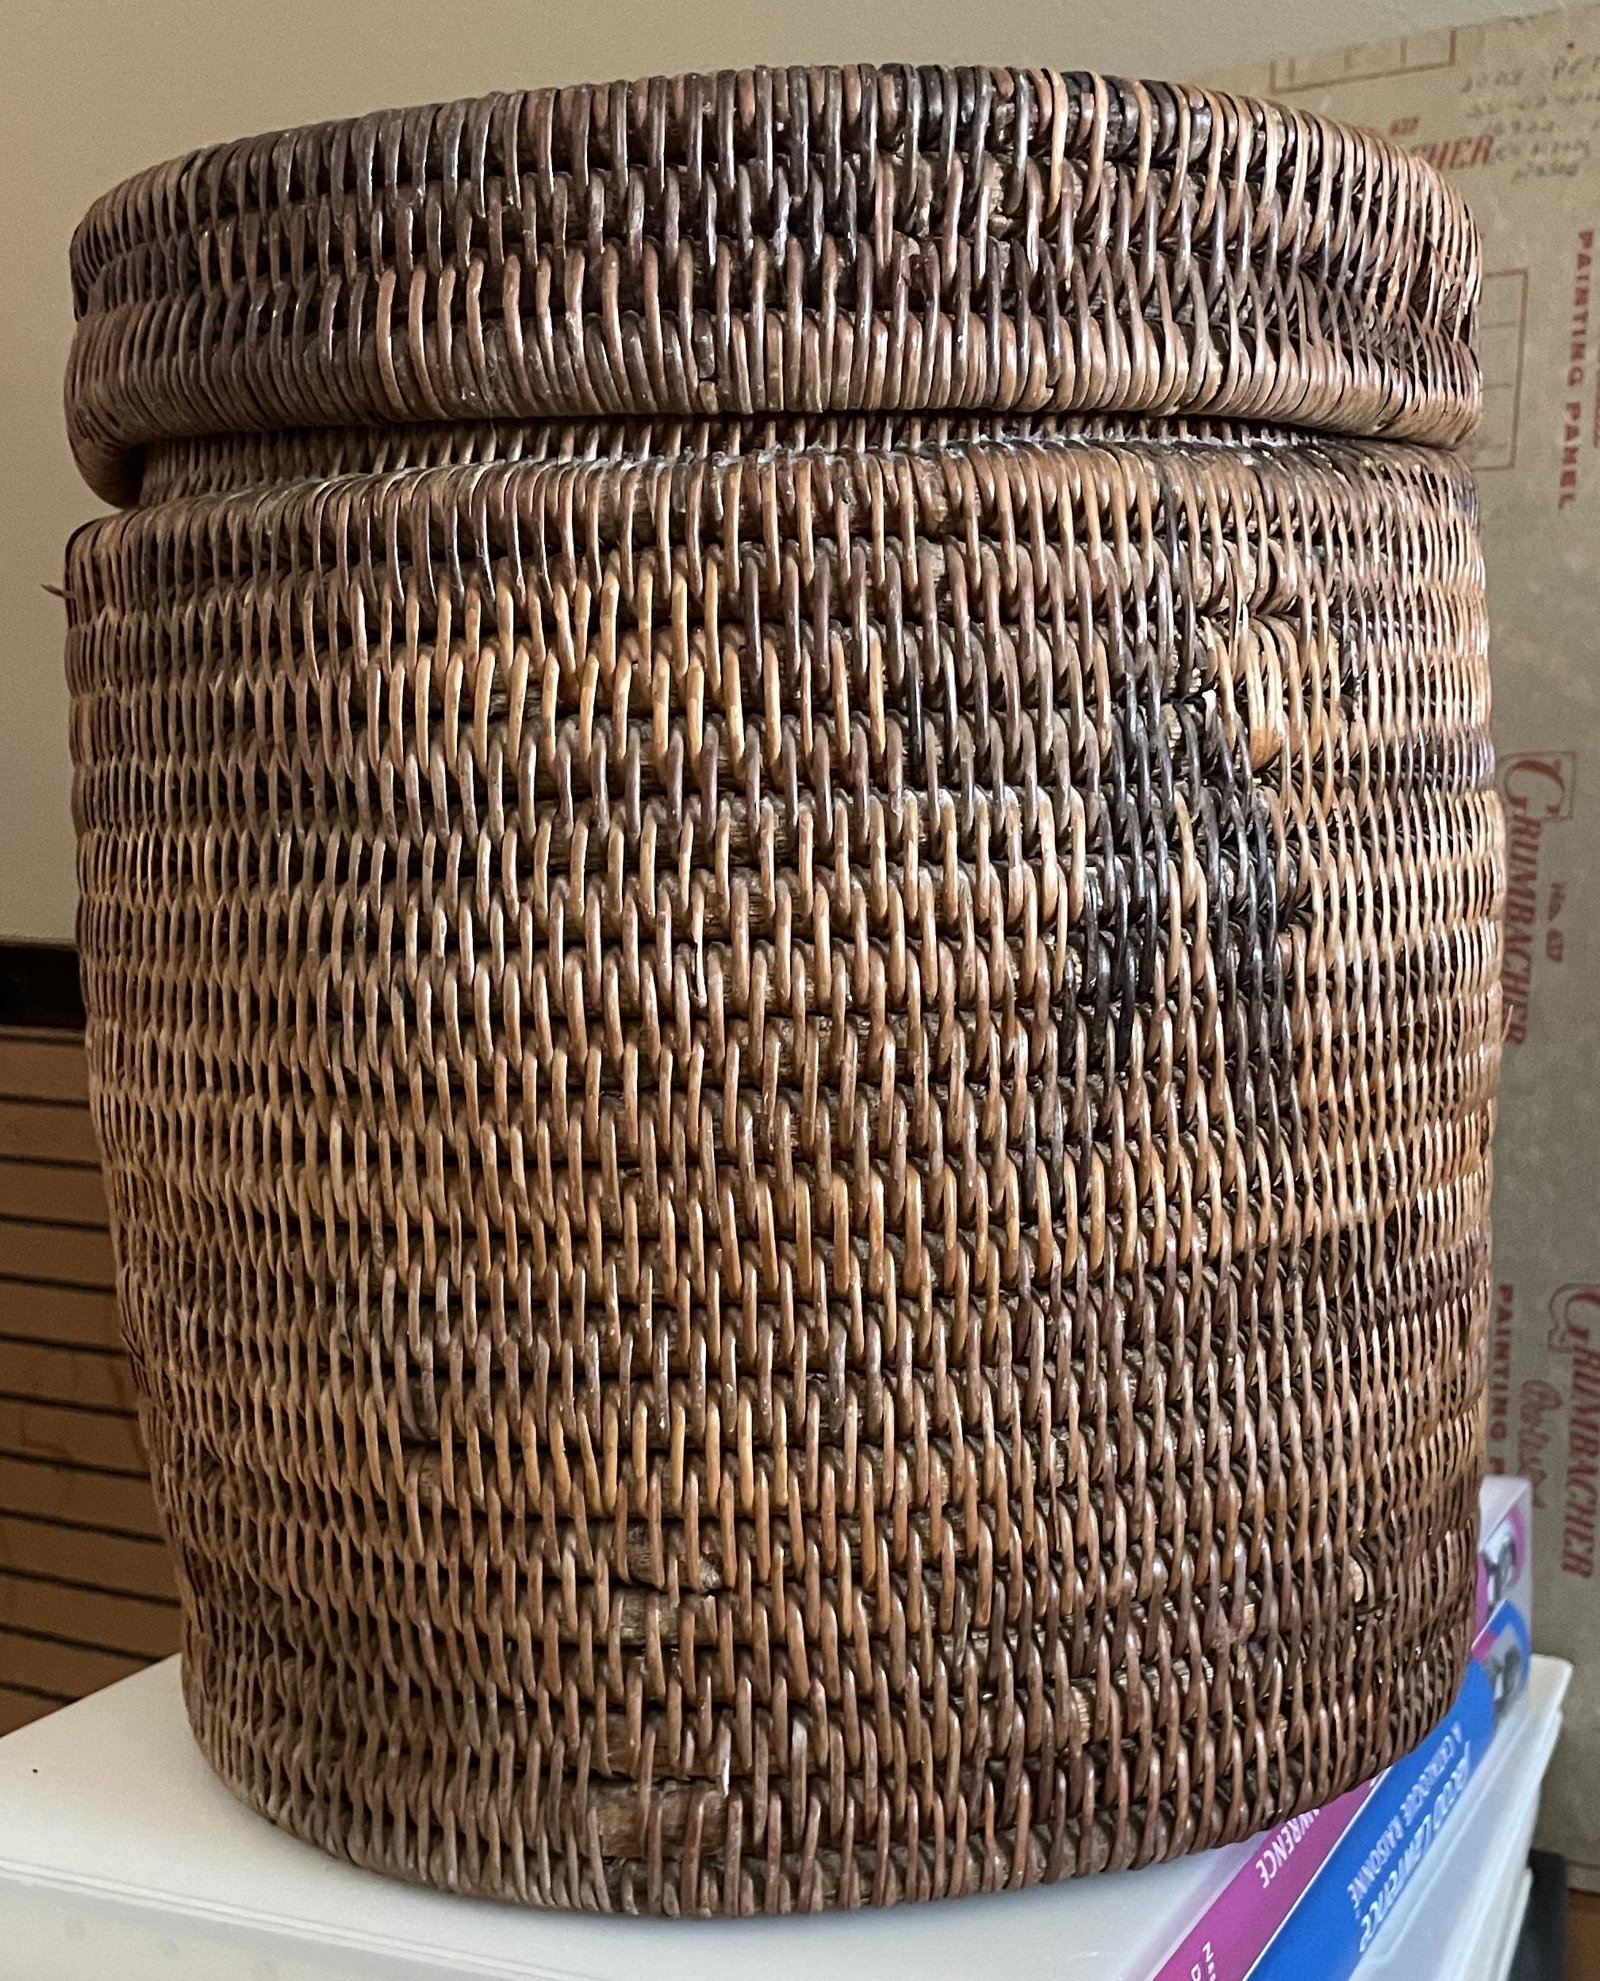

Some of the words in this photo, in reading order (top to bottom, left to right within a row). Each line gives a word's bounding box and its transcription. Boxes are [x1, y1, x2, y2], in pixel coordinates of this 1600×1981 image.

[1567, 230, 1594, 387] PAINTING
[1548, 401, 1581, 510] PANEL
[1503, 758, 1565, 1046] GRUMBACHER
[1489, 1284, 1514, 1442] PAINTING
[1560, 1286, 1600, 1579] GRUMBACHER
[1256, 1808, 1320, 1889] WRENCE
